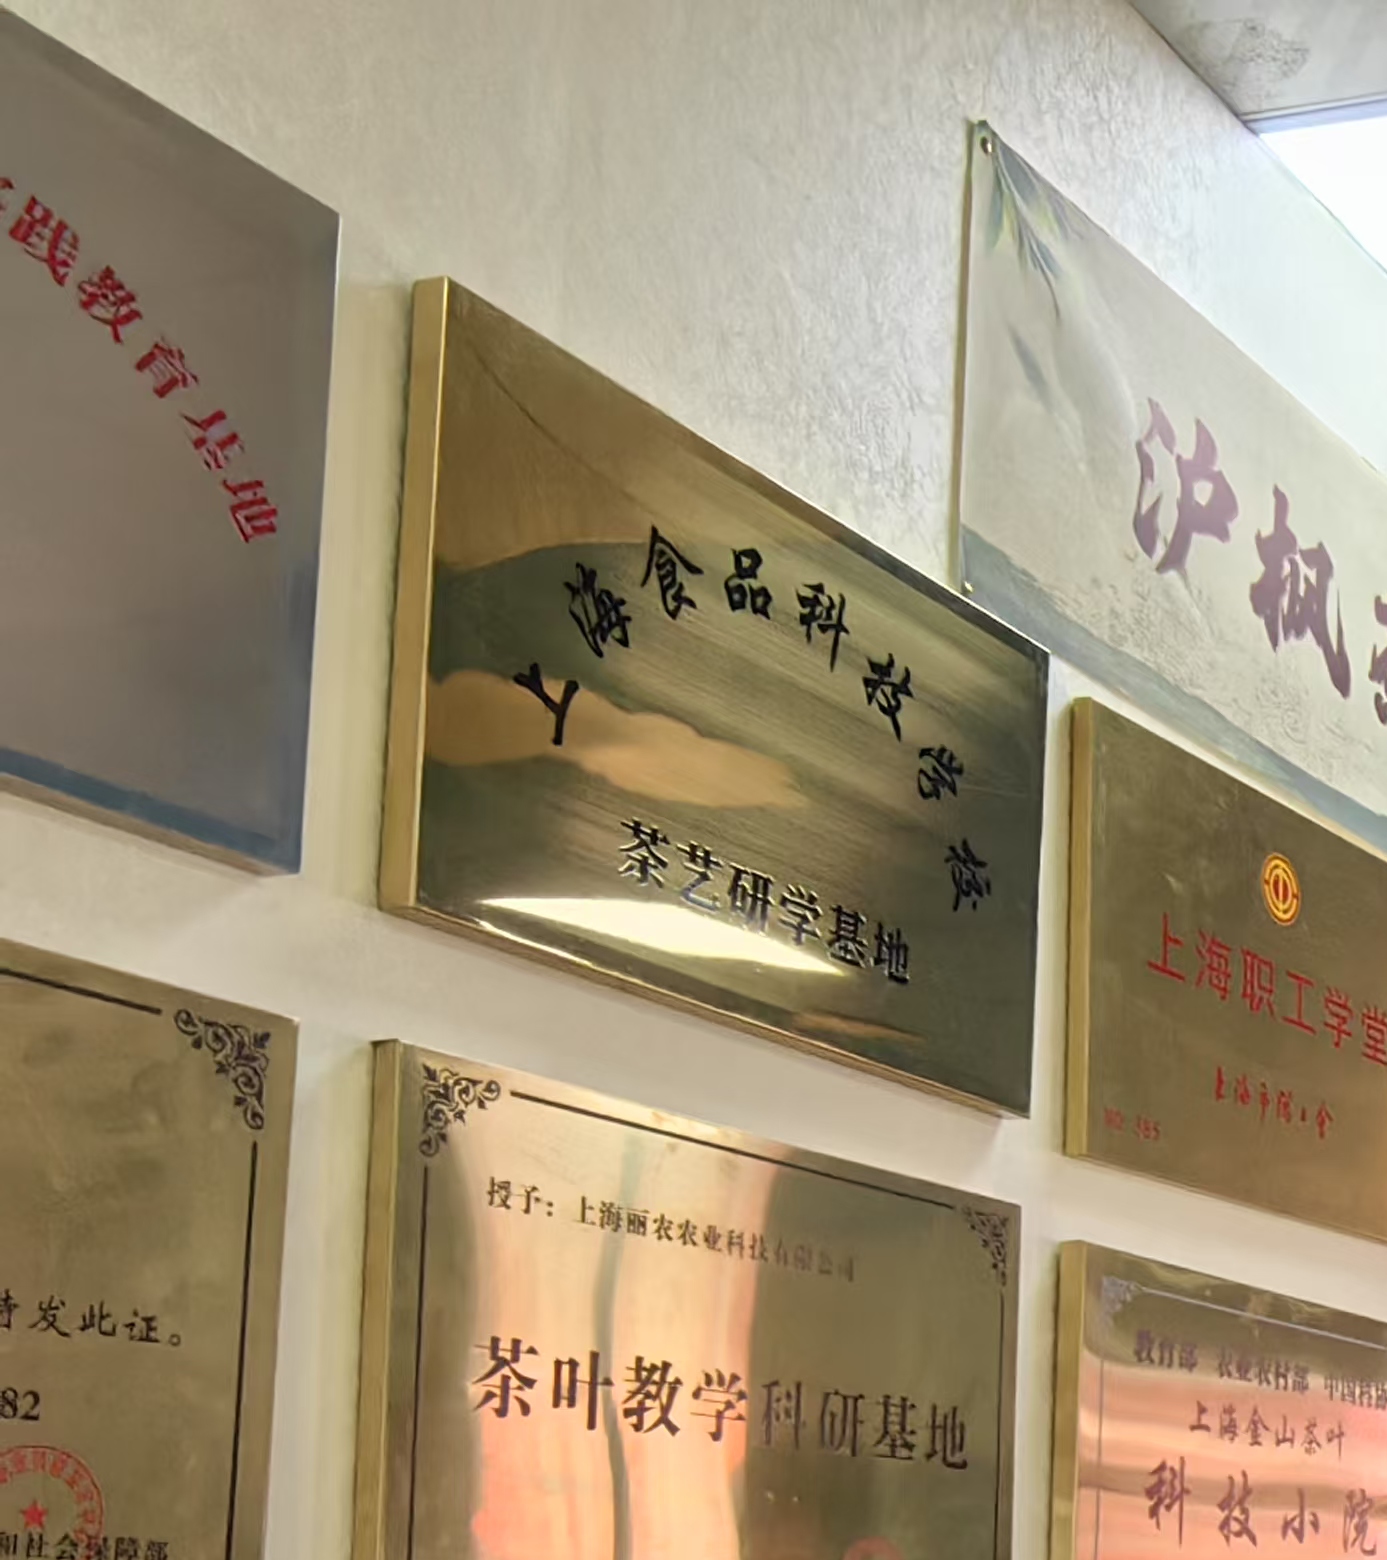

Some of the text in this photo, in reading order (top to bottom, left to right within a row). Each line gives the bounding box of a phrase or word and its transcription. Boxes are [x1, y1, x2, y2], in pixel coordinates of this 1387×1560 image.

[0, 178, 278, 543] 践教育基地
[619, 819, 911, 985] 茶艺研学基地
[471, 1334, 969, 1471] 茶叶教学科研基地
[1188, 1400, 1345, 1459] 上海金山茶叶
[1143, 1455, 1378, 1557] 科技小院
